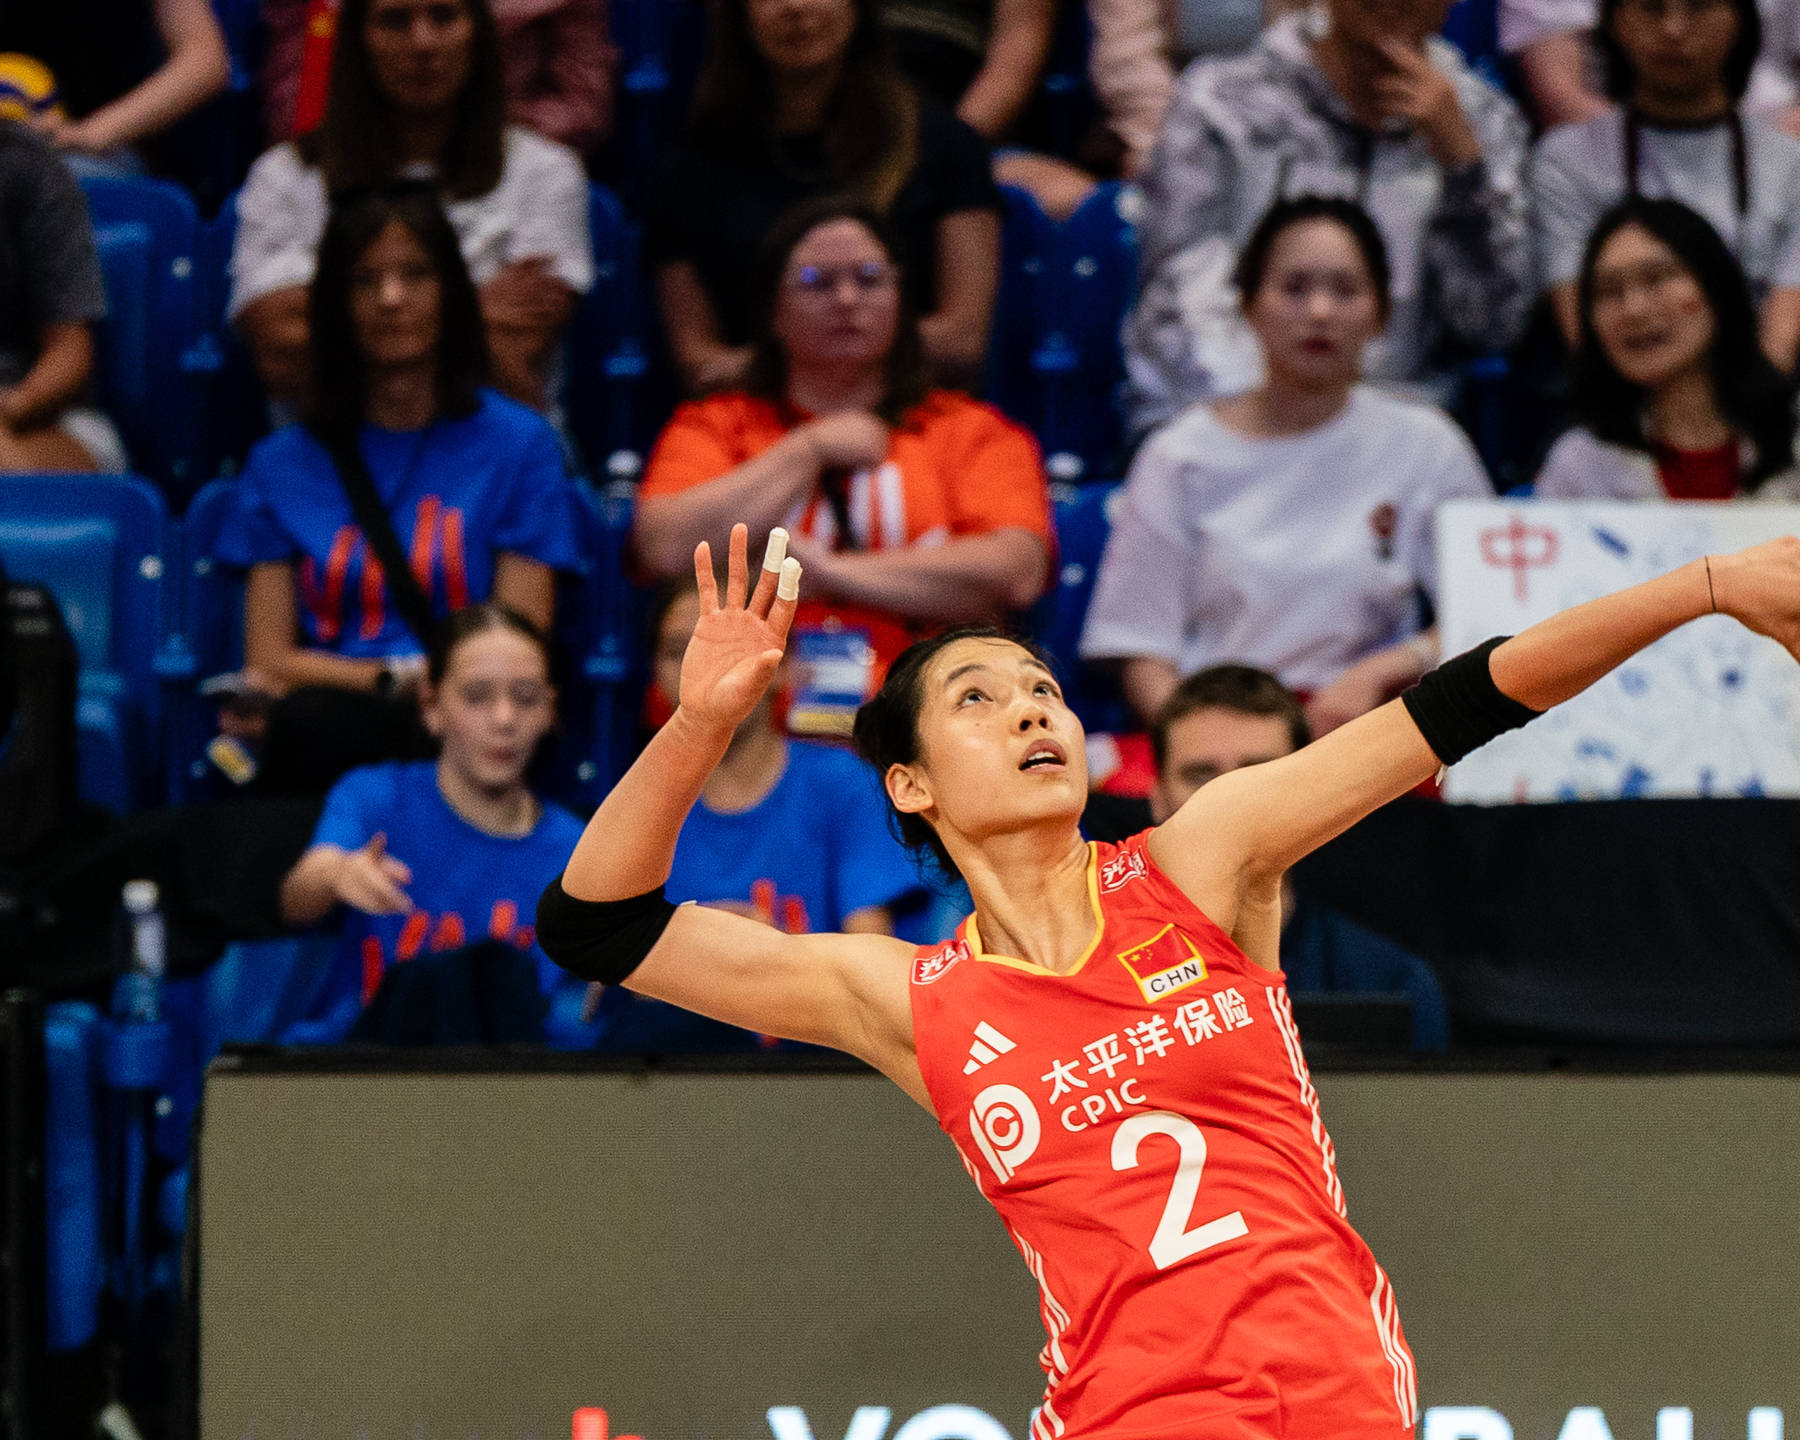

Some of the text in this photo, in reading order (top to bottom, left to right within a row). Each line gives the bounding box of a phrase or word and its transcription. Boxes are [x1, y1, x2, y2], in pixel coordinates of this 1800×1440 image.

[1478, 511, 1560, 604] 中
[1149, 964, 1200, 996] CHN
[1041, 989, 1254, 1105] 太平洋保险
[1060, 1078, 1147, 1133] CPIC
[1110, 1110, 1249, 1271] 2
